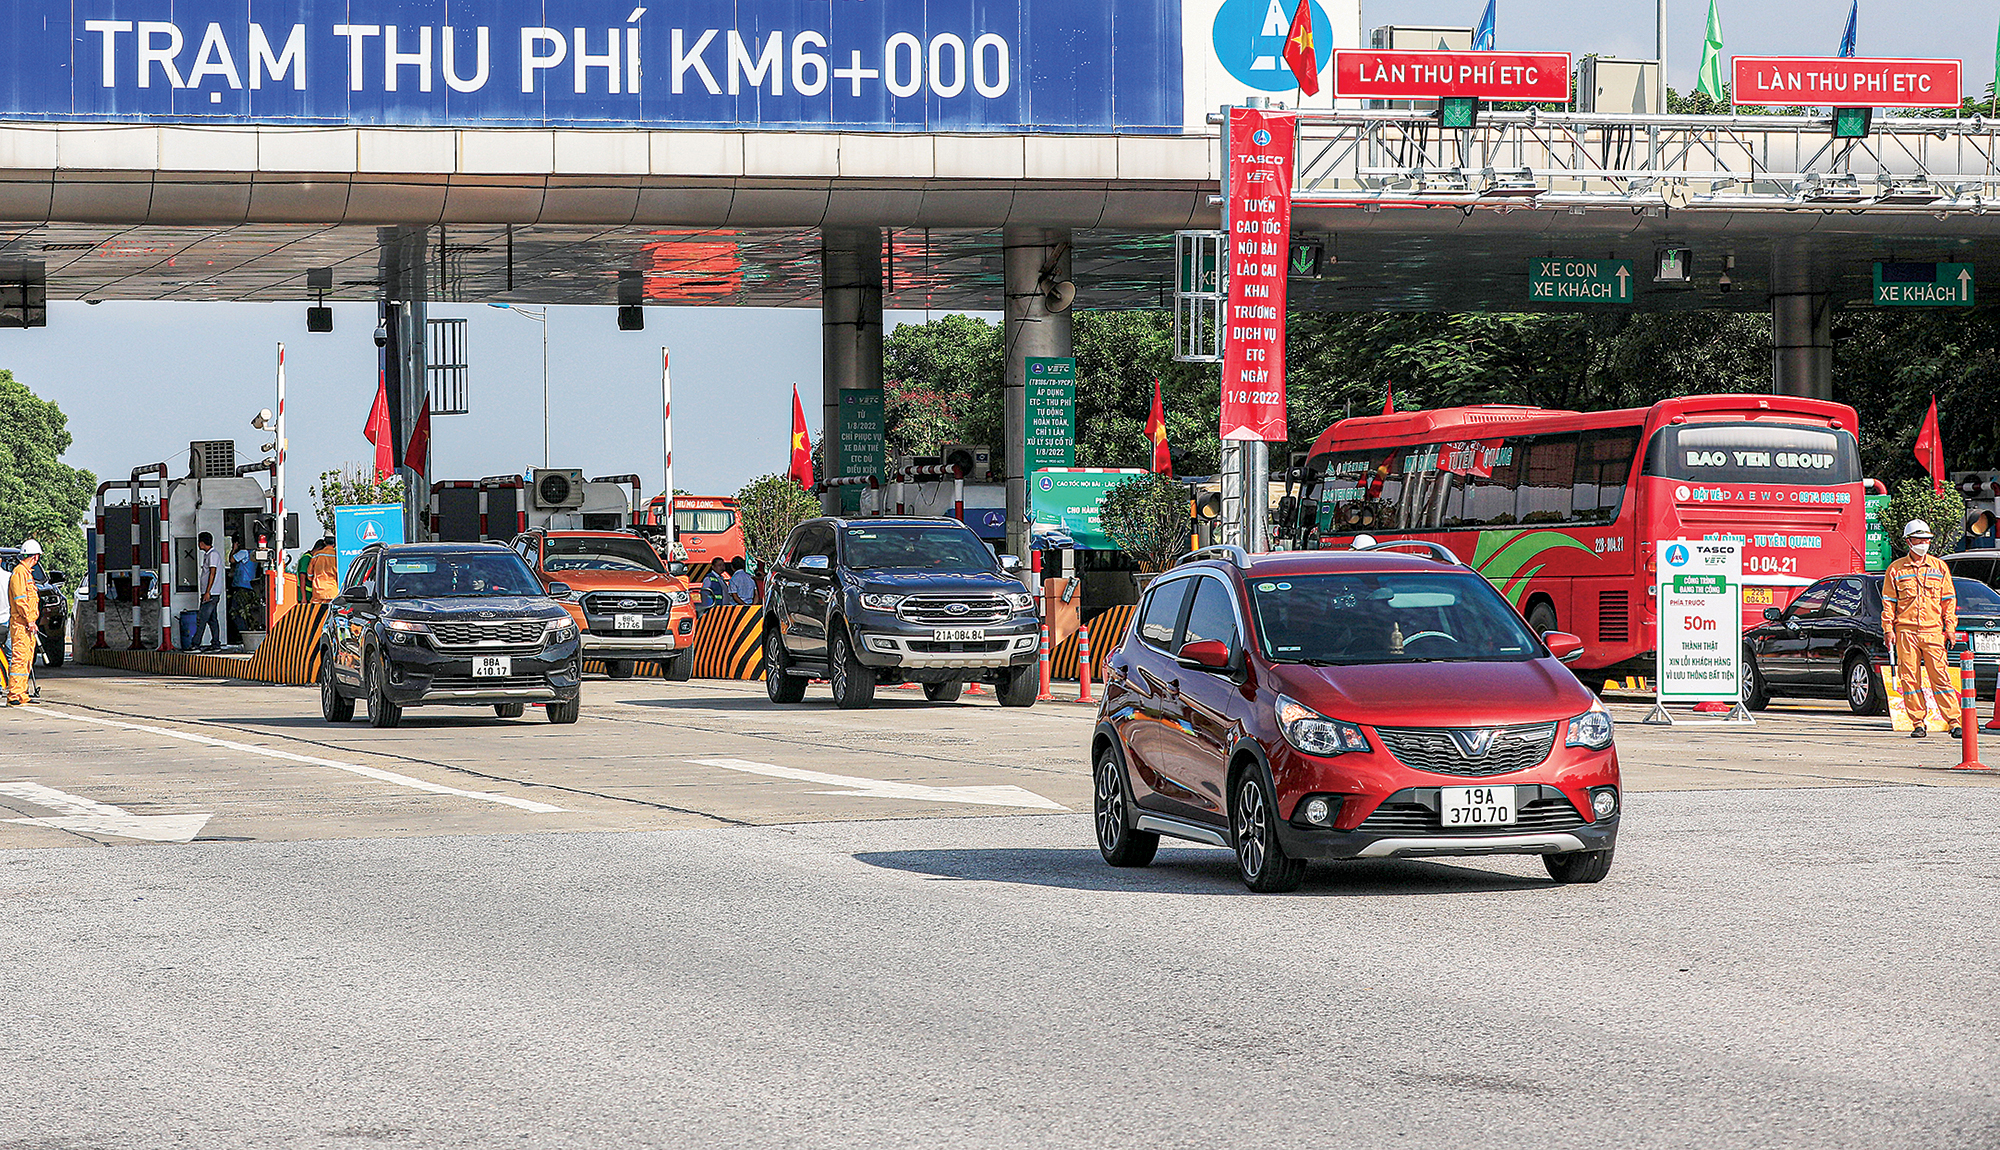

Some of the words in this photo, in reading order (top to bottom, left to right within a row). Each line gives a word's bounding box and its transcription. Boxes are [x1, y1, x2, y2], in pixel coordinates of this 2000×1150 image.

[85, 20, 306, 103] TRẠM
[333, 25, 490, 93] THU
[520, 8, 648, 94] PHÍ
[671, 29, 1010, 99] KM6+000
[1359, 58, 1405, 83] LÀN
[1411, 64, 1453, 84] THU
[1459, 61, 1497, 85] PHÍ
[1501, 66, 1539, 85] ETC
[1757, 66, 1801, 91] LÀN
[1806, 72, 1848, 92] THU
[1853, 68, 1890, 92] PHÍ
[1893, 74, 1932, 93] ETC
[1237, 154, 1284, 165] TASCO
[1246, 170, 1275, 183] VETC
[1243, 195, 1276, 213] TUYẾN
[1236, 220, 1259, 234] CAO
[1262, 217, 1281, 235] TỐC
[1238, 239, 1258, 257] NỘI
[1261, 239, 1277, 256] BÀI
[1236, 260, 1258, 276] LÀO
[1261, 264, 1277, 277] CAI
[1540, 262, 1561, 277] XE
[1565, 262, 1597, 278] CON
[1244, 284, 1269, 298] KHAI
[1534, 281, 1554, 297] XE
[1558, 279, 1612, 298] KHÁCH
[1879, 286, 1899, 301] XE
[1903, 283, 1956, 301] KHÁCH
[1234, 305, 1277, 320] TRƯƠNG
[1233, 326, 1261, 343] DỊCH
[1264, 328, 1277, 344] VỤ
[1246, 348, 1266, 362] ETC
[1240, 366, 1269, 383] NGÀY
[1029, 398, 1041, 406] ETC
[1046, 398, 1059, 407] THU
[1060, 396, 1072, 407] PHÍ
[1227, 390, 1280, 405] 1/8/2022
[844, 443, 852, 452] XE
[1035, 448, 1065, 457] 1/8/2022
[850, 454, 862, 463] ETC
[1686, 451, 1727, 467] BAO
[1732, 451, 1771, 467] YEN
[1775, 452, 1835, 470] GROUP
[696, 500, 714, 509] LONG
[1066, 506, 1081, 515] CHO
[1753, 532, 1787, 548] TUYÊN
[1788, 535, 1822, 550] QUANG
[1696, 546, 1735, 554] TASCO
[1683, 615, 1717, 631] 50m
[935, 630, 983, 641] 21A-084.84
[1681, 640, 1702, 651] THÀNH
[483, 657, 500, 667] 88A
[1669, 657, 1680, 666] XIN
[1713, 656, 1732, 667] HÀNG
[476, 666, 507, 676] 410.17
[1464, 788, 1494, 805] 19A
[1450, 806, 1508, 824] 370.70
